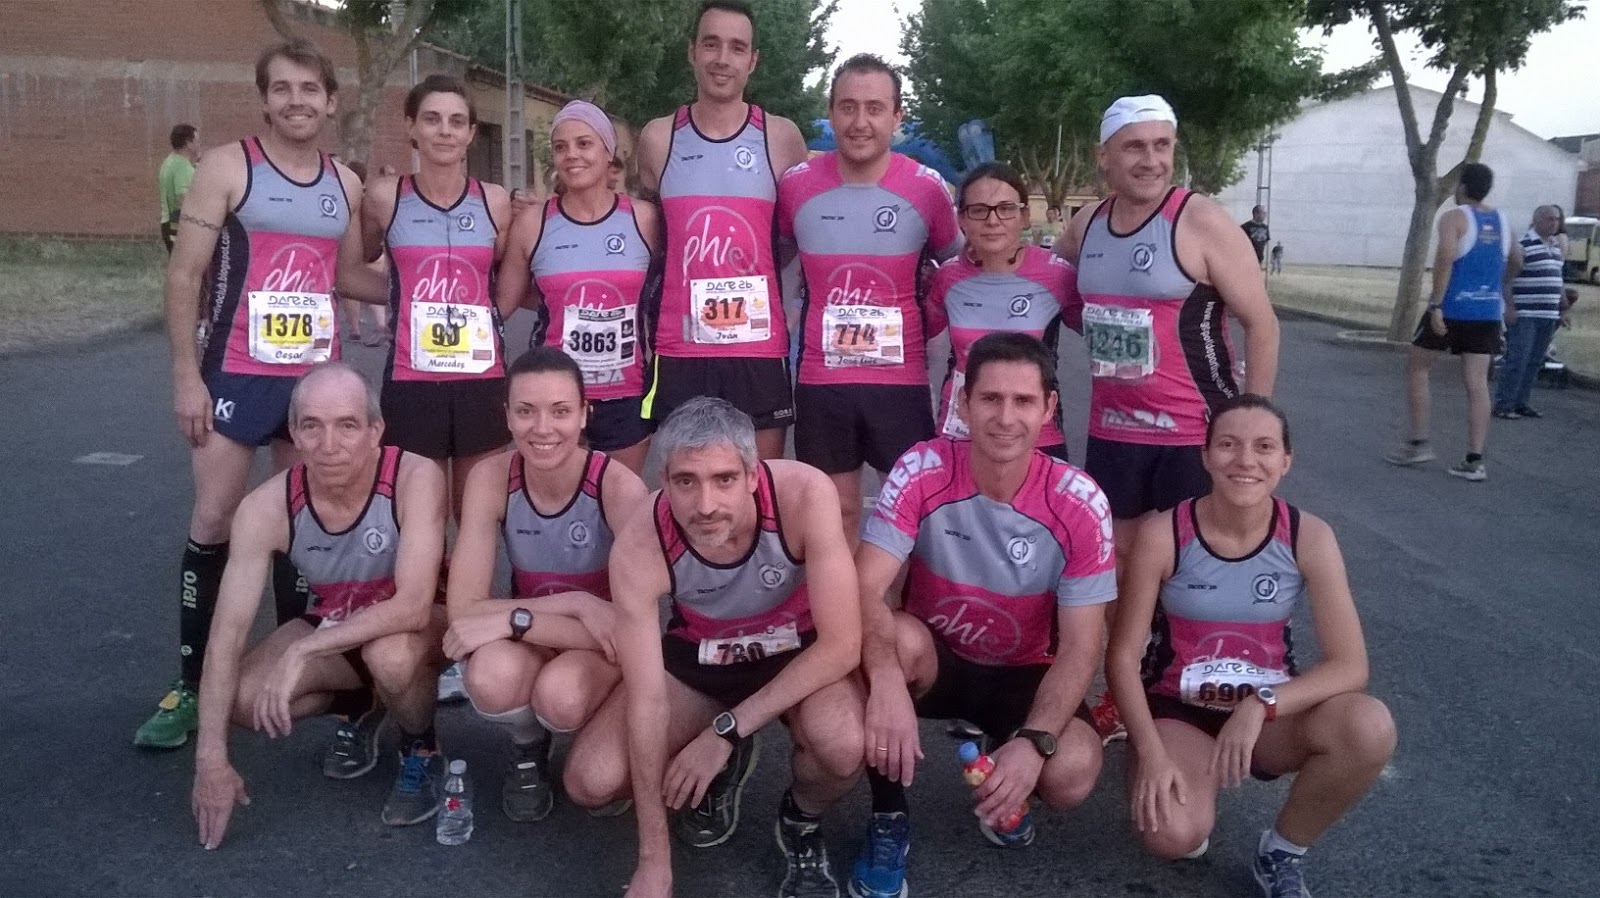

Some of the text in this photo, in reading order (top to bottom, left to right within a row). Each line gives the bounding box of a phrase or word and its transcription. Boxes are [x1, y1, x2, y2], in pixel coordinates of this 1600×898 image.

[704, 297, 744, 320] 317
[263, 313, 312, 337] 1378
[835, 323, 876, 345] 774
[569, 330, 617, 353] 3863
[1199, 682, 1255, 702] 690
